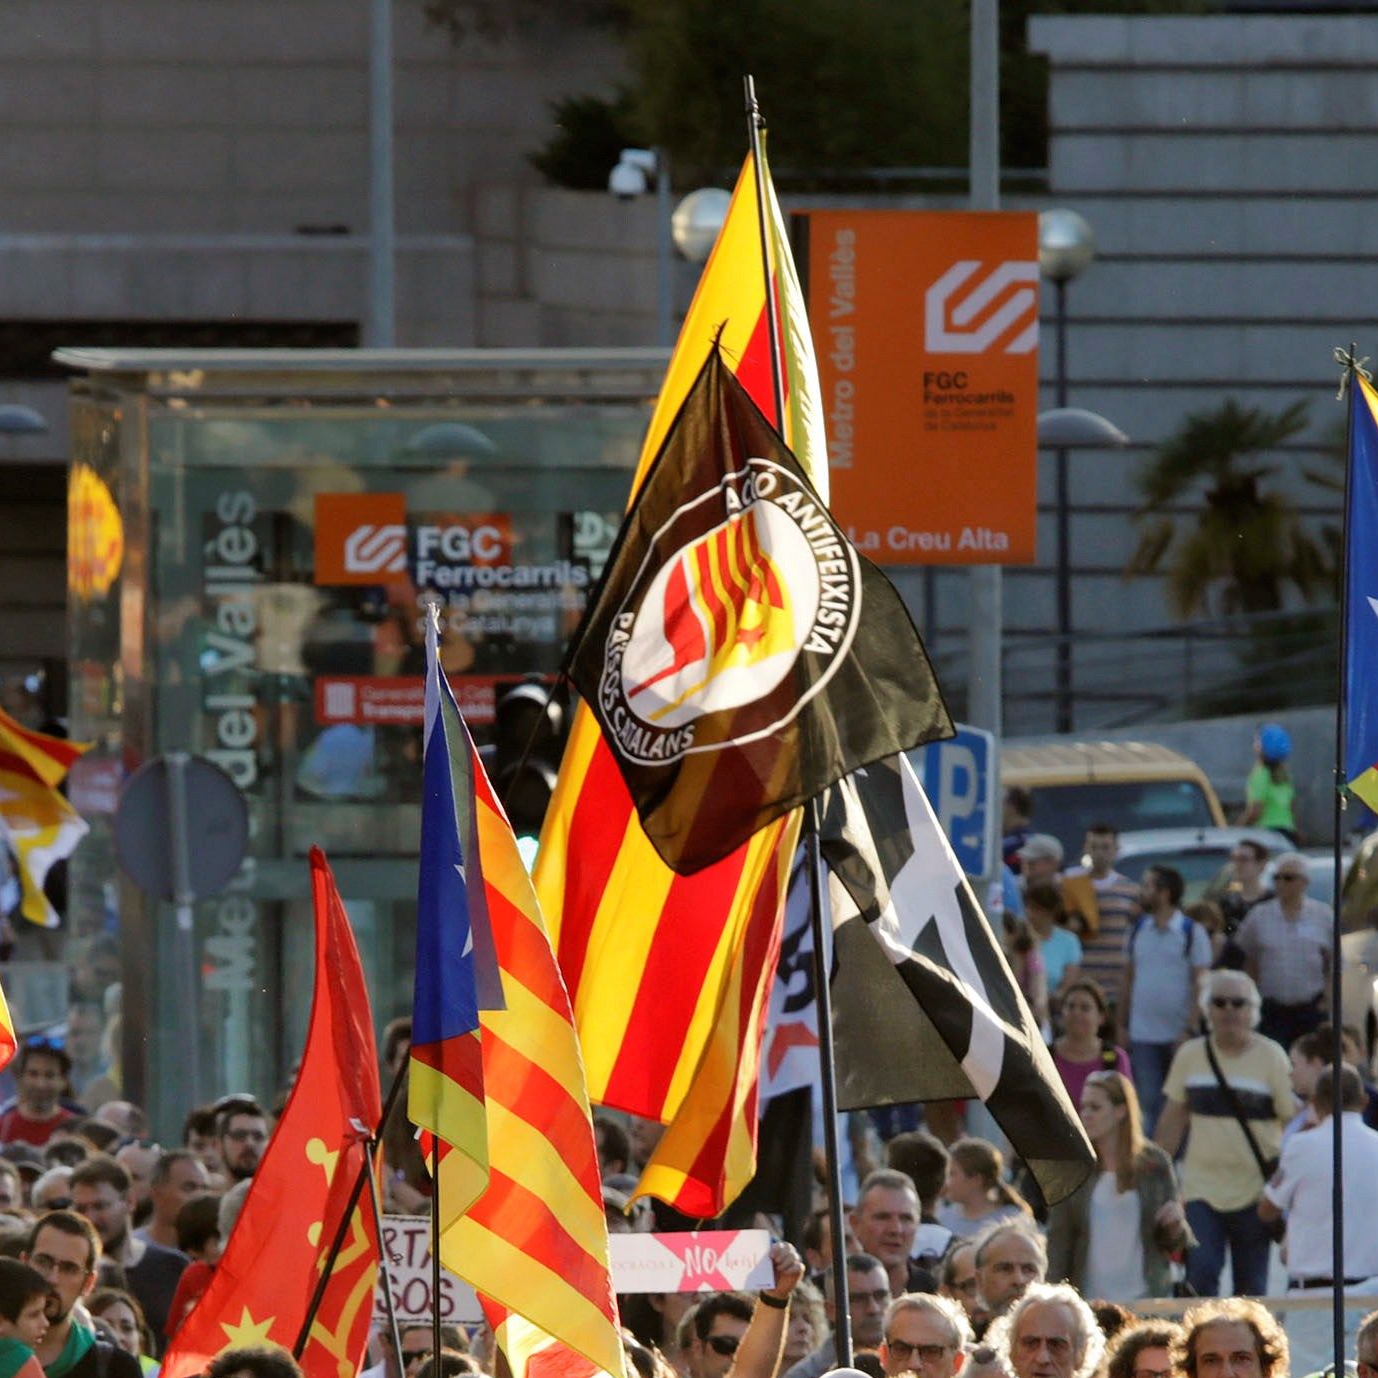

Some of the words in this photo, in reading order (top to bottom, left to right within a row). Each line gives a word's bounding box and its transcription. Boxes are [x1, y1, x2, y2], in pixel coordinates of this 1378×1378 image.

[829, 228, 856, 318] Vallès
[829, 324, 855, 373] del
[924, 371, 969, 390] FGC
[829, 380, 855, 469] Metro
[415, 525, 502, 561] FGC
[850, 527, 881, 549] La
[887, 526, 951, 549] Creu
[958, 527, 1010, 550] Alta
[203, 490, 257, 674] Vallès
[415, 560, 589, 586] Ferrocarrils
[775, 490, 850, 655] ANTIFEIXISTA
[204, 692, 257, 788] del
[940, 744, 981, 851] P
[685, 1245, 718, 1278] NO
[376, 1273, 455, 1317] SOS
